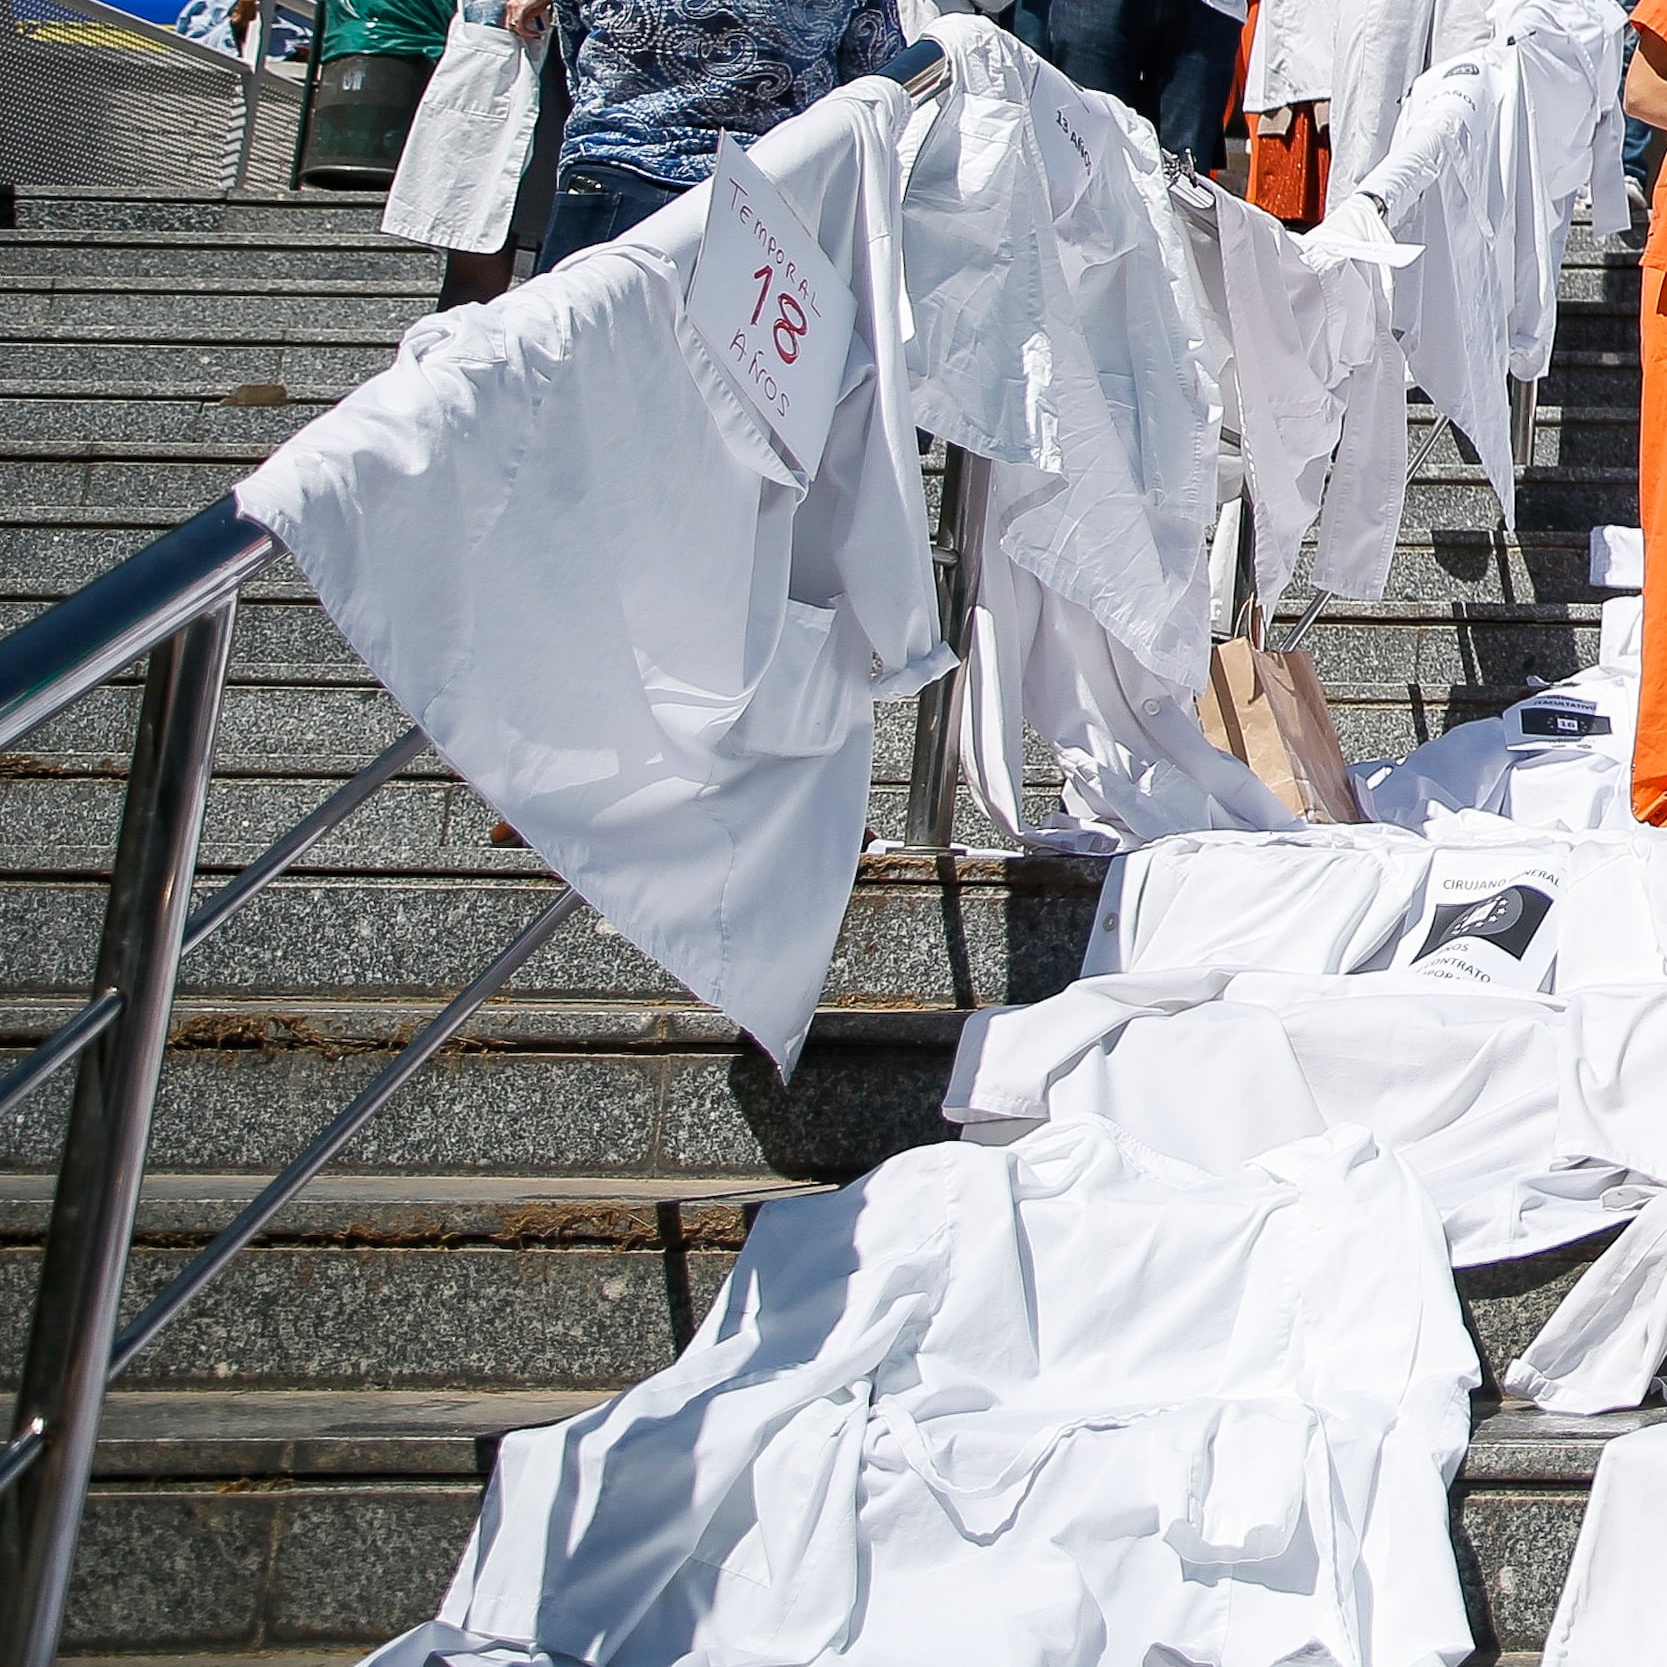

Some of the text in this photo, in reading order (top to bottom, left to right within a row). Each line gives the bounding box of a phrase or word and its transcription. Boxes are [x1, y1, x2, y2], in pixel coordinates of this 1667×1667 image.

[727, 175, 824, 319] TEMPORAL
[749, 263, 810, 367] 18
[728, 326, 792, 419] AÑOS
[1443, 878, 1506, 892] CIRUJANO
